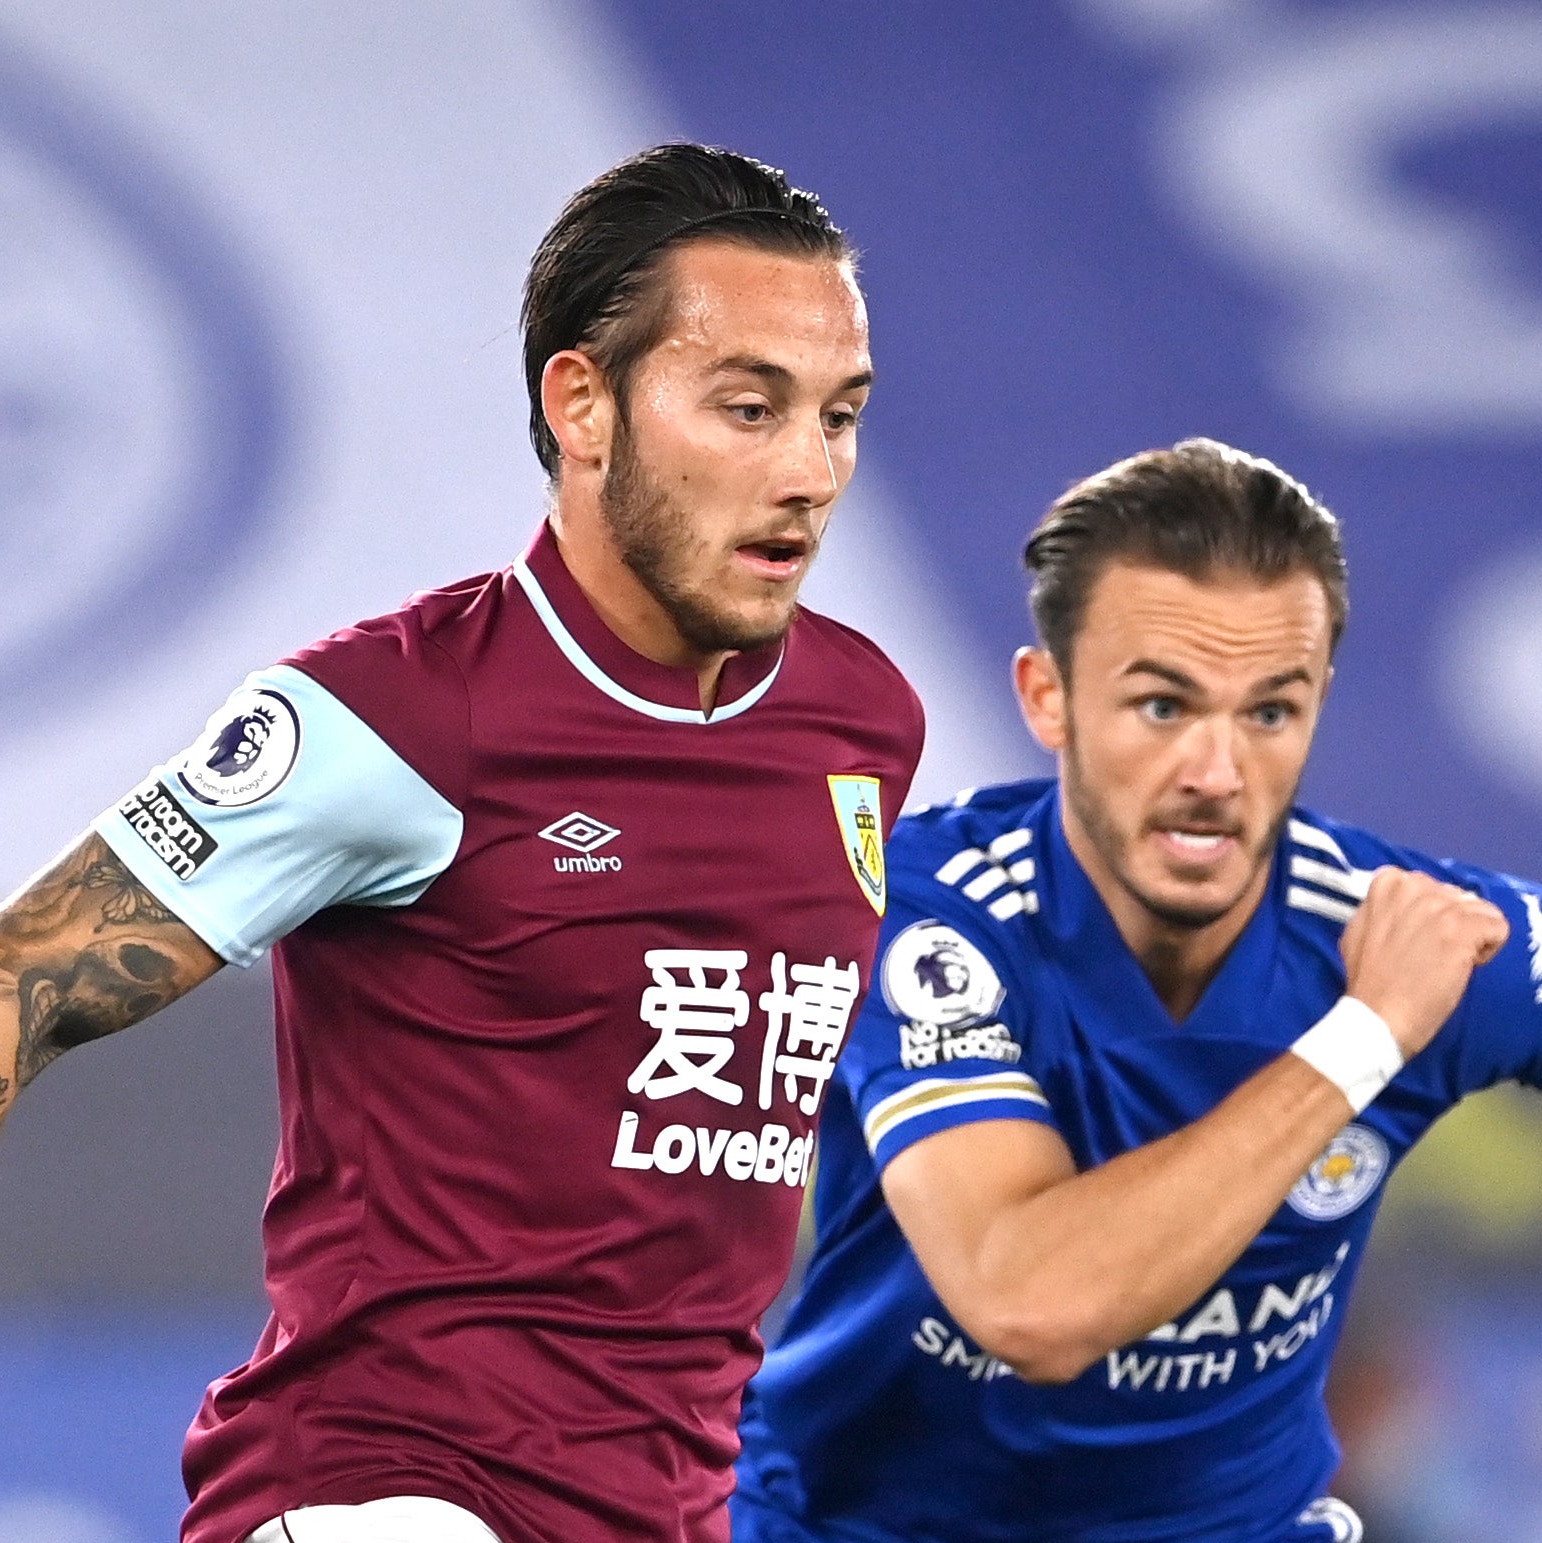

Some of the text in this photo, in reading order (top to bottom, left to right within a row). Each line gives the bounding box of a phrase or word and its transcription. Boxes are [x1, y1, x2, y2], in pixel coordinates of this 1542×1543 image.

[194, 770, 268, 795] Premier League
[129, 808, 196, 879] racism
[148, 795, 203, 855] room
[553, 852, 622, 873] umbro
[627, 949, 859, 1116] 爱博
[611, 1110, 814, 1188] LoveBet
[1107, 1348, 1238, 1392] WITH
[1252, 1292, 1334, 1372] YOU
